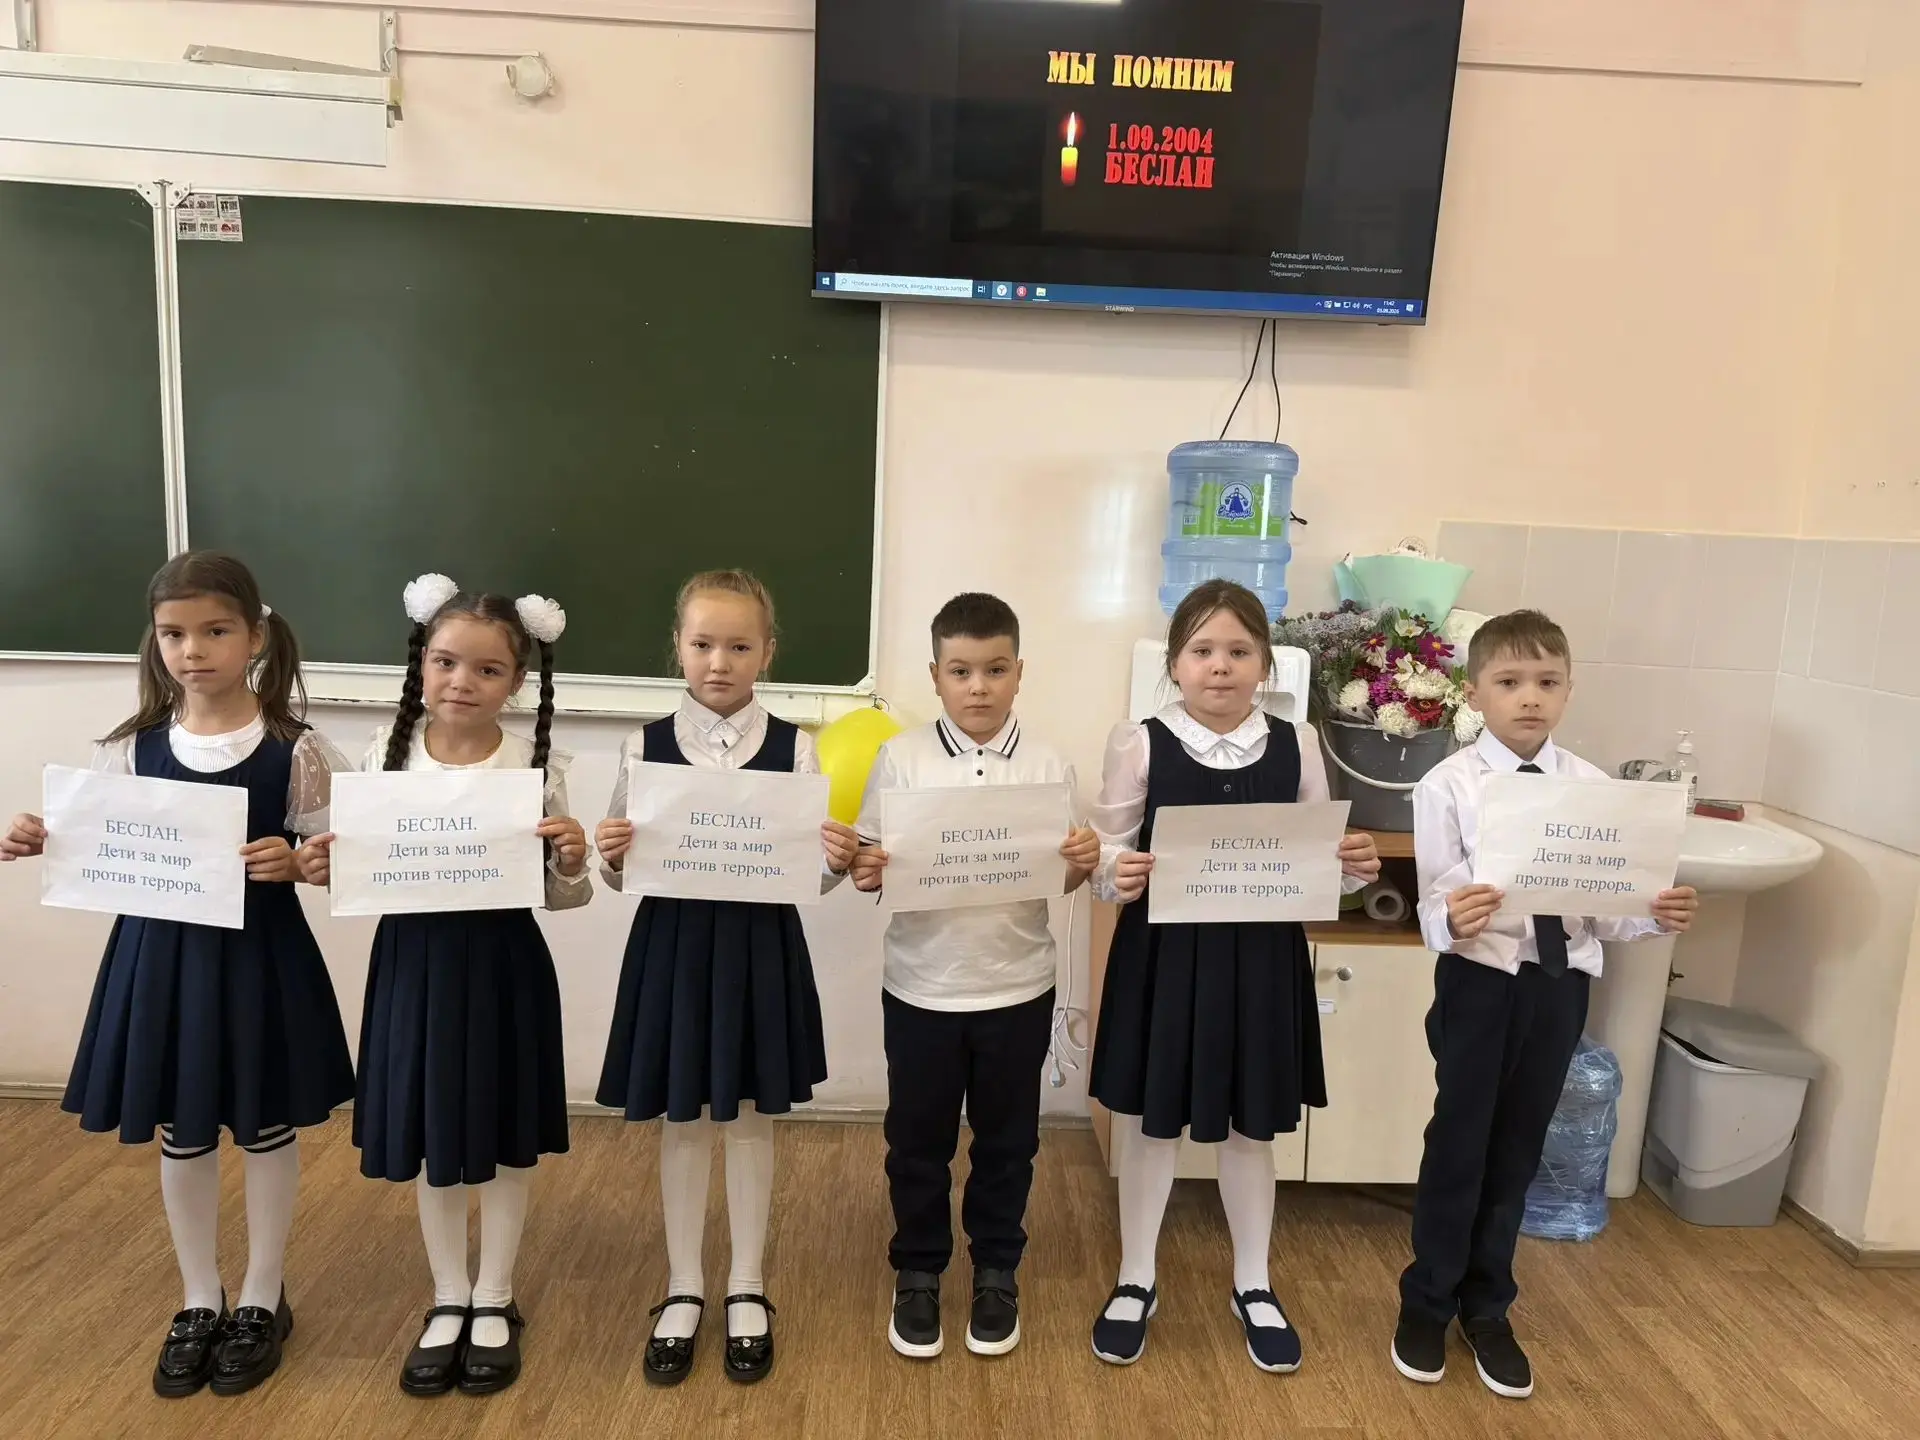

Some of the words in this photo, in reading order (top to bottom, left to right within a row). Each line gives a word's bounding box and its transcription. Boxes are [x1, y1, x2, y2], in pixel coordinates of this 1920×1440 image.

[1047, 51, 1096, 85] МЫ
[1112, 54, 1234, 92] ПОМНИМ
[1108, 123, 1213, 154] 1.09.2004
[1104, 151, 1215, 188] БЕСЛАН
[1270, 251, 1310, 260] Активация
[1312, 252, 1344, 261] Windows
[105, 818, 183, 842] БЕСЛАН.
[397, 816, 477, 832] БЕСЛАН.
[690, 811, 766, 830] БЕСЛАН.
[941, 827, 1012, 844] БЕСЛАН.
[1545, 822, 1622, 843] БЕСЛАН.
[388, 843, 428, 860] Дети
[433, 845, 449, 856] за
[455, 843, 487, 858] мир
[679, 834, 717, 851] Дети
[722, 840, 737, 851] за
[743, 842, 773, 856] мир
[1210, 837, 1284, 850] БЕСЛАН.
[97, 842, 135, 861] Дети
[140, 851, 156, 863] за
[161, 854, 192, 870] мир
[933, 852, 969, 867] Дети
[972, 853, 987, 863] за
[992, 850, 1020, 863] мир
[1532, 846, 1572, 865] Дети
[1576, 853, 1592, 865] за
[1596, 855, 1627, 871] мир
[373, 869, 430, 885] против
[435, 866, 504, 882] террора.
[662, 858, 716, 873] против
[721, 862, 785, 878] террора.
[1200, 858, 1237, 873] Дети
[1241, 861, 1257, 872] за
[1261, 861, 1291, 875] мир
[81, 867, 136, 883] против
[140, 874, 206, 895] террора.
[919, 873, 969, 888] против
[973, 870, 1032, 884] террора.
[1515, 872, 1569, 888] против
[1573, 875, 1636, 894] террора.
[1186, 882, 1237, 897] против
[1241, 883, 1304, 897] террора.
